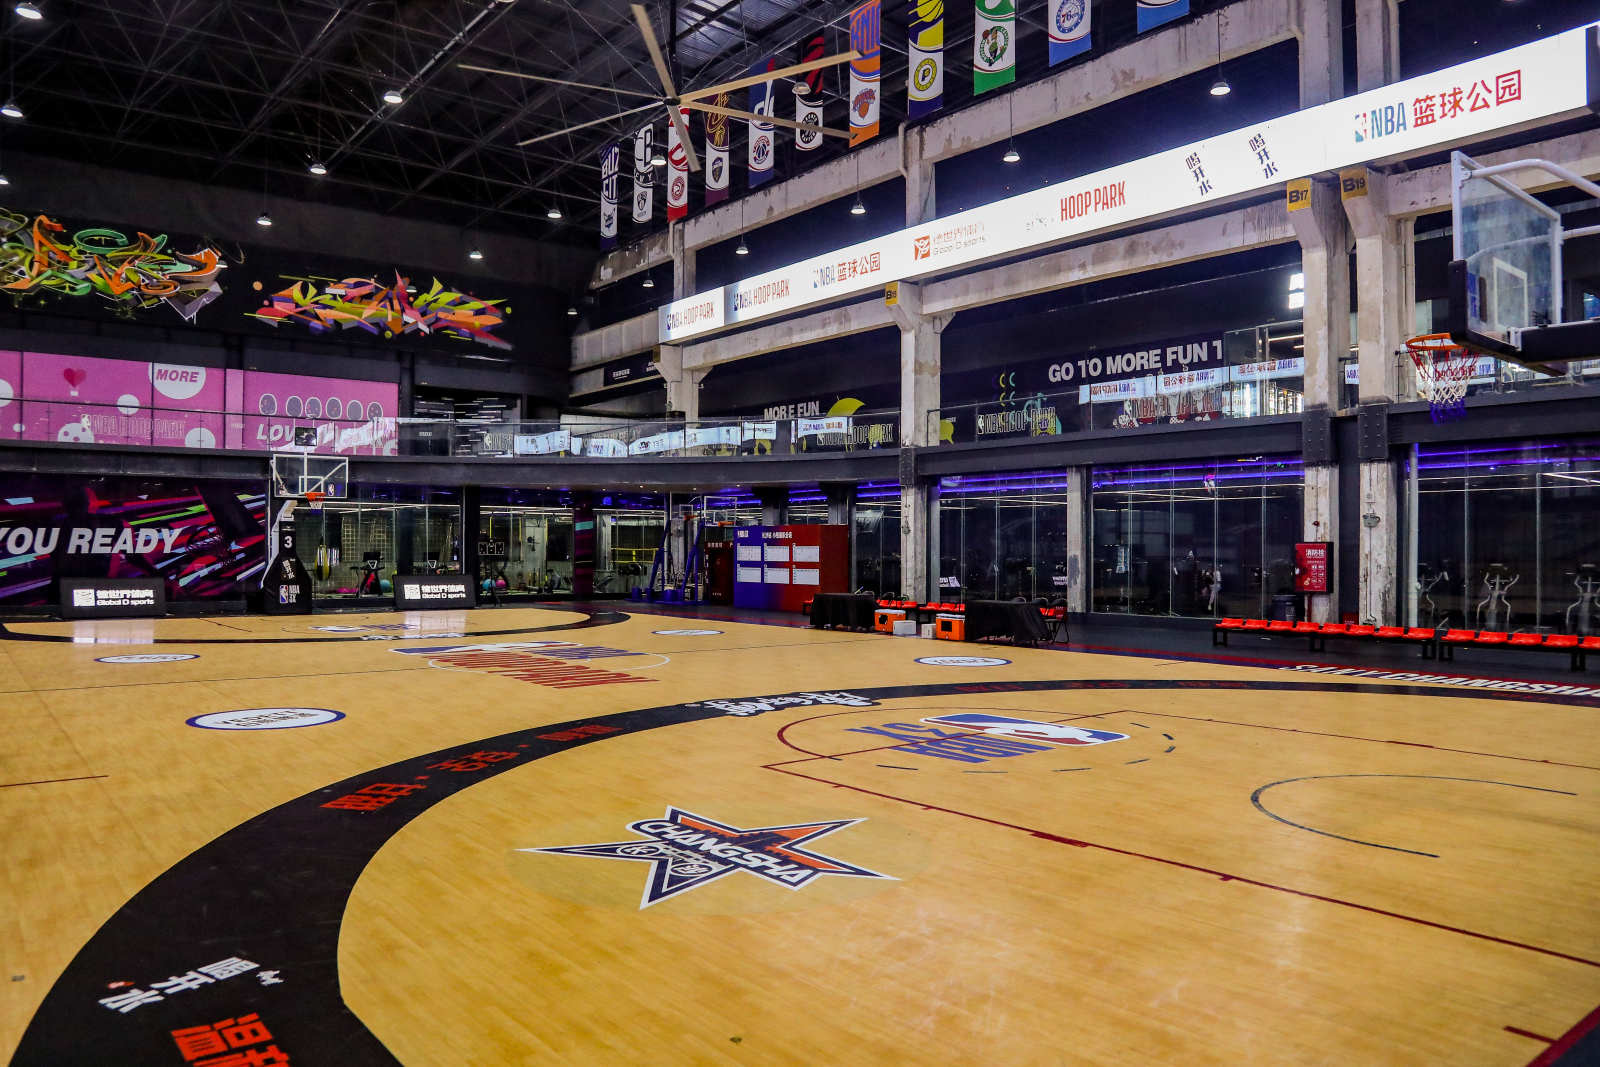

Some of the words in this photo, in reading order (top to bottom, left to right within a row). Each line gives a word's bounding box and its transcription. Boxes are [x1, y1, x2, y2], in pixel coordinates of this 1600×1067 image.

[1371, 102, 1407, 139] NBA
[1413, 70, 1522, 128] 篮球公园
[1248, 133, 1279, 179] 喝开水
[1185, 152, 1213, 196] 喝开水
[1342, 177, 1366, 192] B19
[1060, 190, 1092, 222] HOOP
[1094, 180, 1126, 213] PARK
[1289, 189, 1309, 204] B17
[820, 264, 835, 288] NBA
[837, 251, 881, 283] 篮球公园
[739, 291, 753, 310] NBA
[753, 285, 771, 305] HOOP
[772, 279, 790, 301] PARK
[683, 306, 698, 326] HOOP
[699, 301, 715, 322] PARK
[156, 368, 200, 383] MORE
[1048, 362, 1075, 383] GO
[1106, 349, 1163, 375] MORE
[1166, 341, 1208, 367] FUN
[763, 405, 795, 420] MORE
[797, 401, 820, 417] FUN
[67, 527, 183, 554] READY
[284, 535, 293, 549] 3
[130, 598, 155, 607] sports
[288, 585, 300, 594] NBA
[639, 821, 812, 882] CHANGSHA
[98, 956, 260, 1014] 喝开水
